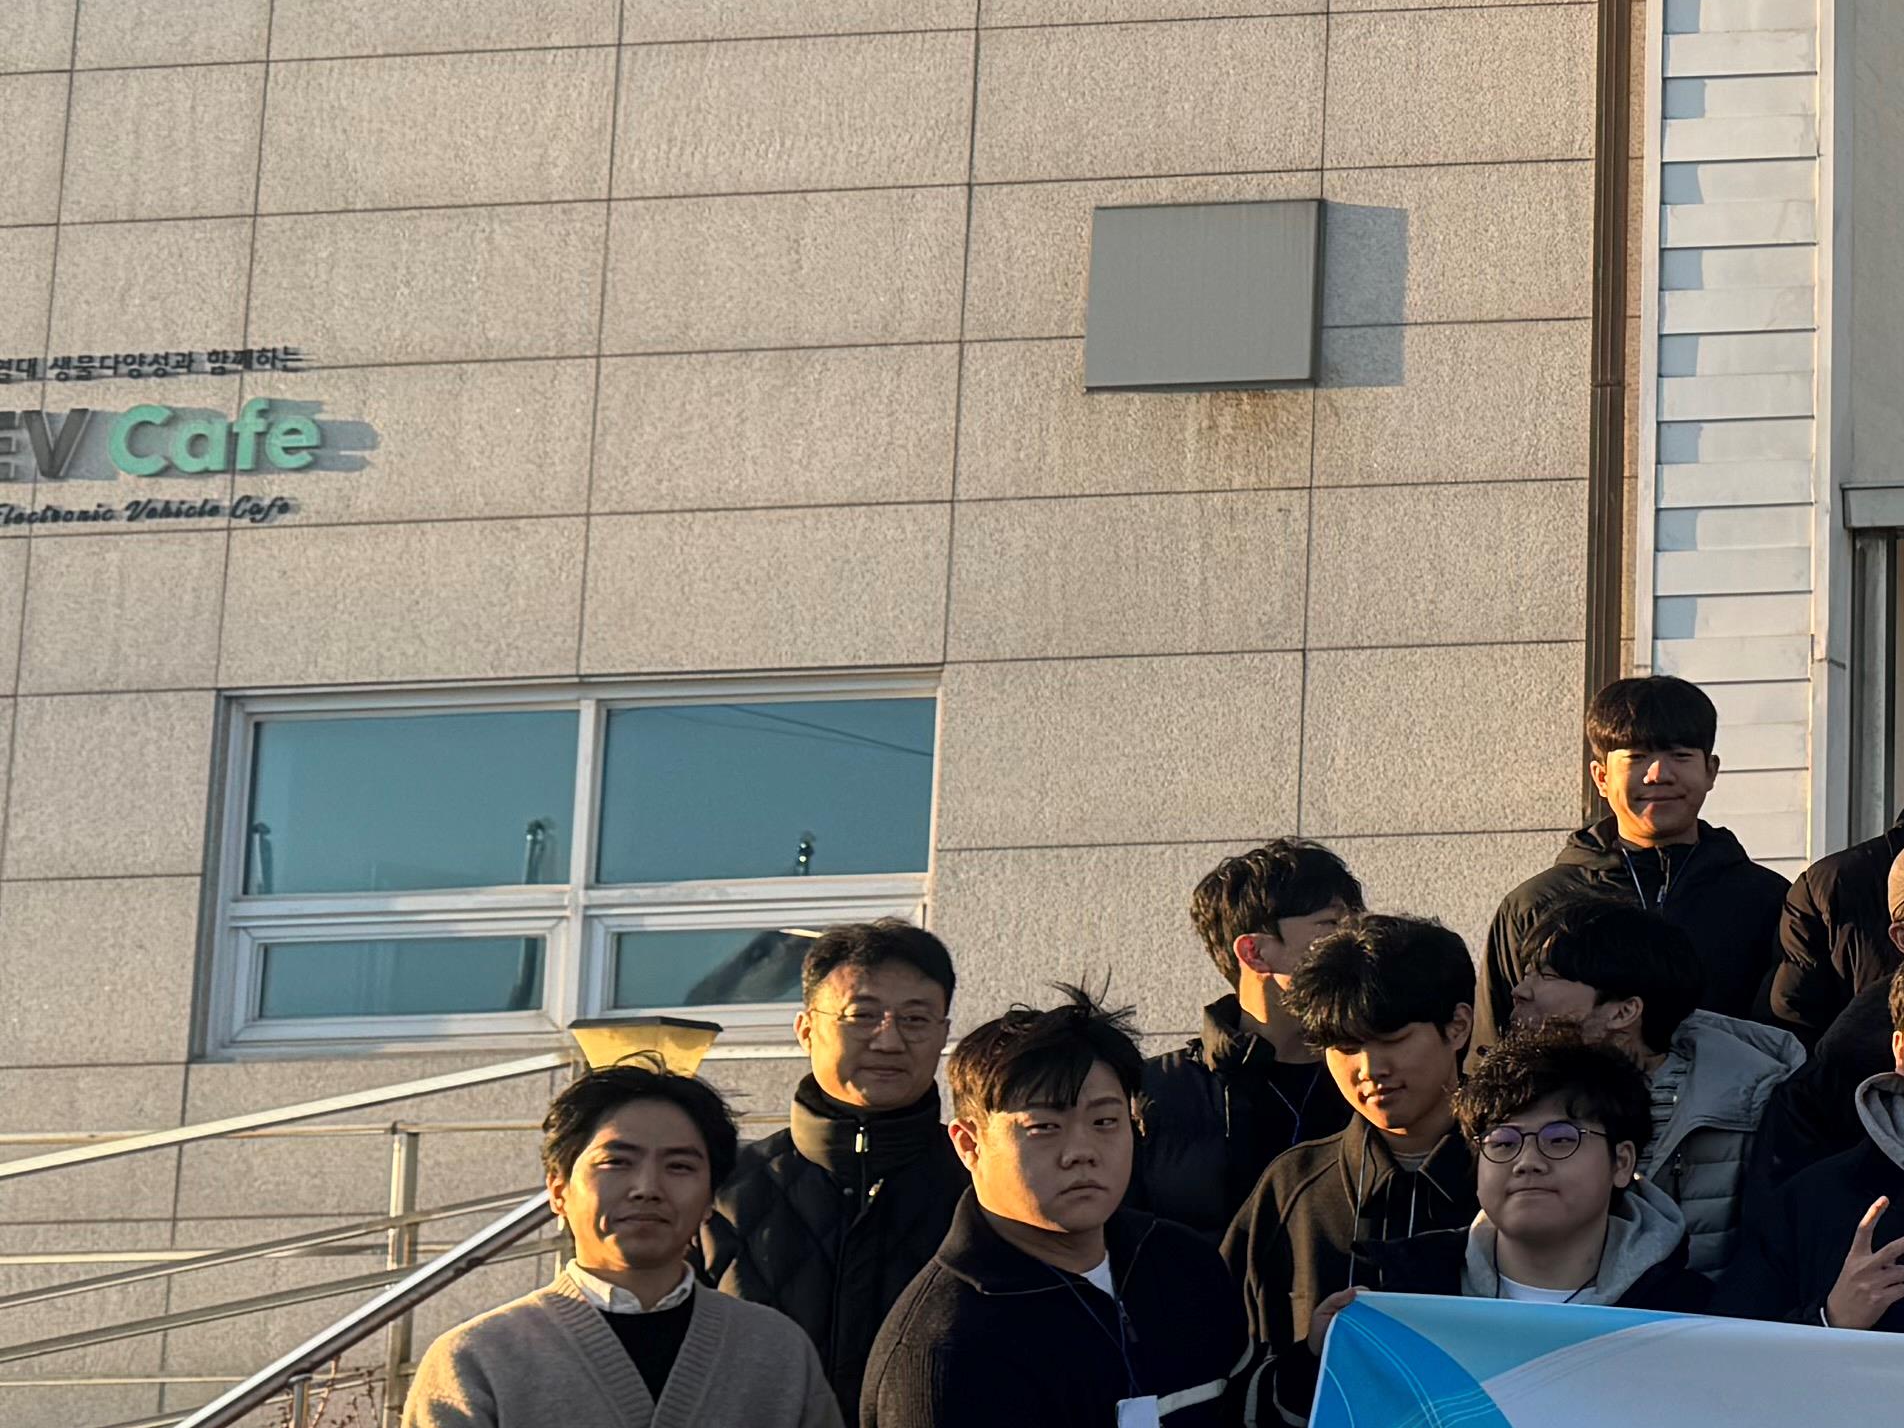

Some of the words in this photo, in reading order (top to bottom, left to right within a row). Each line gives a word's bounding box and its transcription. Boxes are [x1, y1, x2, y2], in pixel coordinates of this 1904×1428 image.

[49, 351, 195, 382] 생물다양성과
[207, 345, 304, 376] 함께하는
[107, 397, 321, 476] Cafe
[125, 498, 221, 521] Vehicle
[230, 494, 291, 523] Cafe
